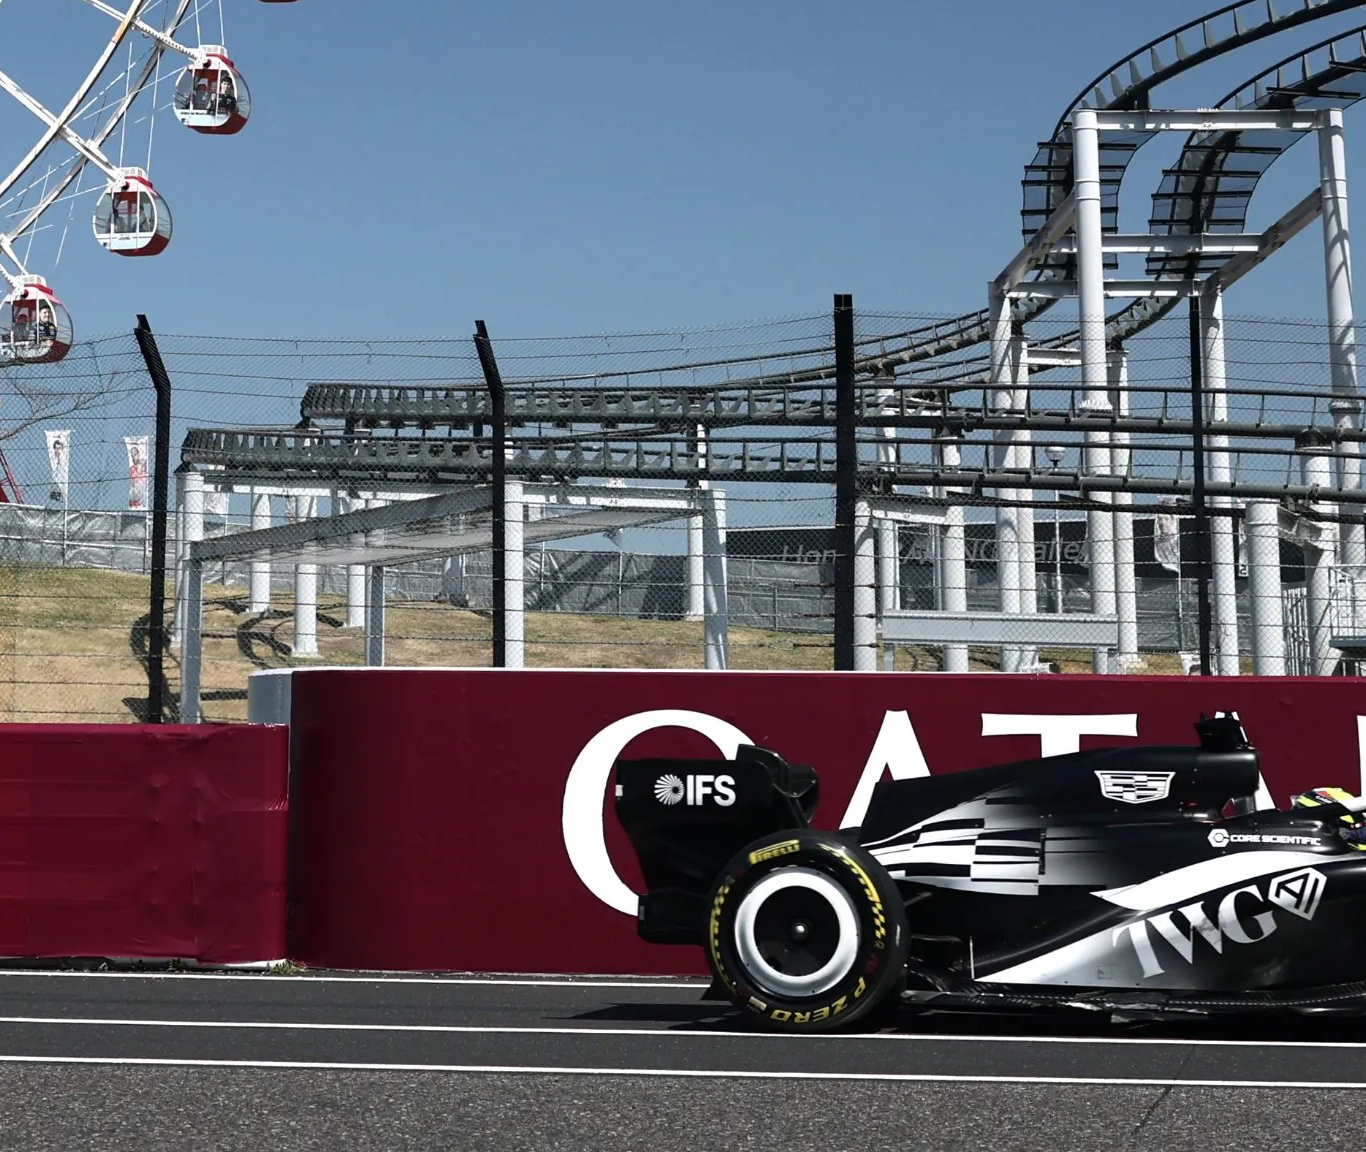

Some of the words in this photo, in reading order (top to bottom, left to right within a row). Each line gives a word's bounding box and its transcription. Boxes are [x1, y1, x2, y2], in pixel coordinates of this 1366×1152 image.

[686, 774, 736, 807] IFS
[748, 839, 800, 865] PIRELLI
[1229, 834, 1260, 843] CORE
[1262, 834, 1321, 846] SCIENTIFIC
[1112, 884, 1278, 979] TWG
[853, 976, 867, 998] P
[770, 995, 849, 1024] ZERO
